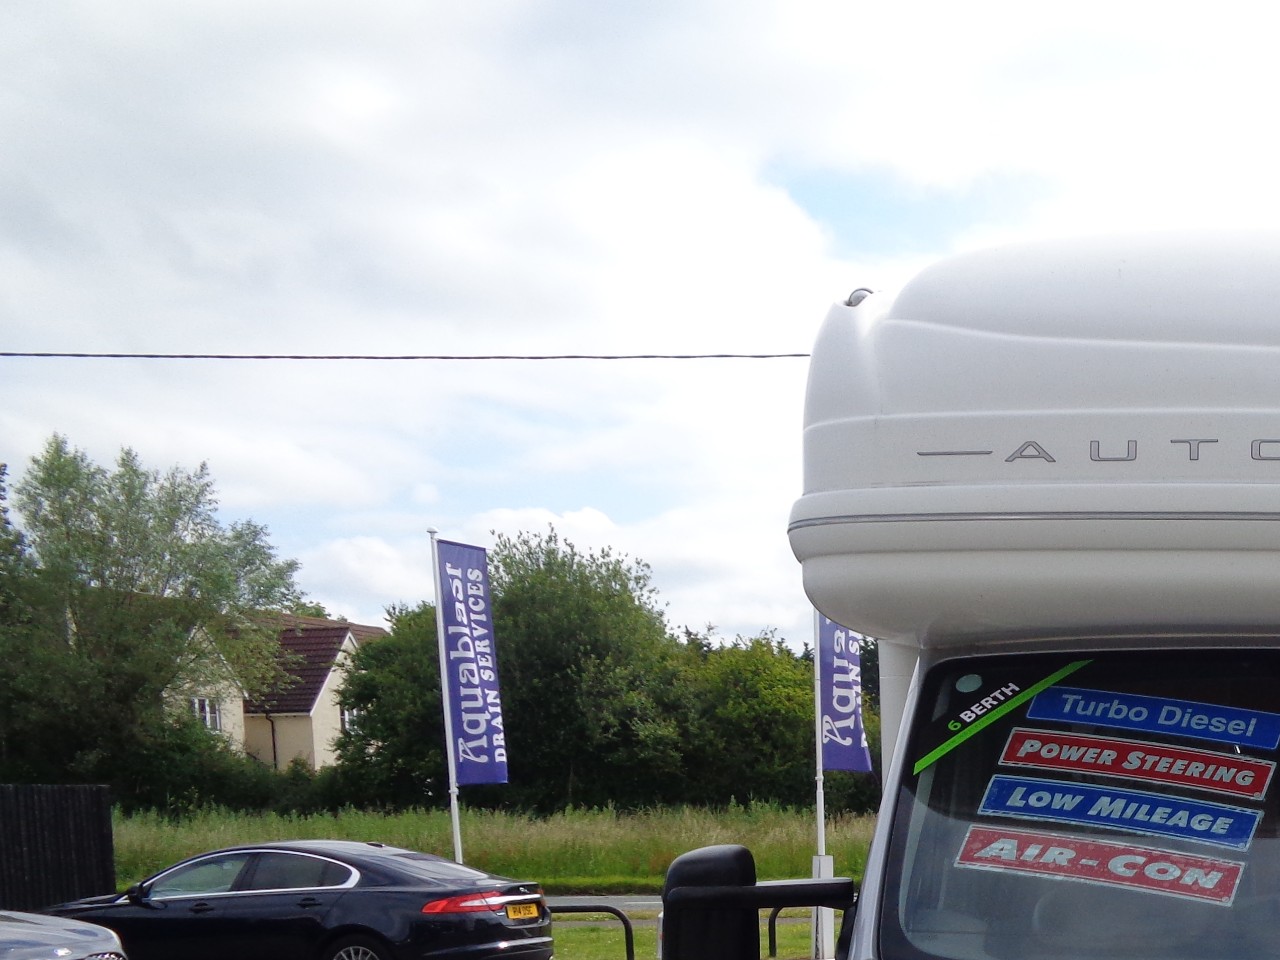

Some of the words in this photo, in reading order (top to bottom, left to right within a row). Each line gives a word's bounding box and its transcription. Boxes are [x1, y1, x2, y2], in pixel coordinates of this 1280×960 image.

[467, 567, 495, 683] SERVICES
[445, 562, 492, 764] Aquablast
[947, 719, 962, 731] 6
[959, 682, 1021, 723] BERTH
[1061, 694, 1149, 723] Turbo
[1157, 705, 1258, 737] Diesel
[1016, 739, 1117, 767] POWER
[1122, 750, 1257, 787] STEERING
[1006, 786, 1085, 811] LOW
[1087, 796, 1234, 835] MILEAGE
[972, 838, 1226, 890] AIR-CON
